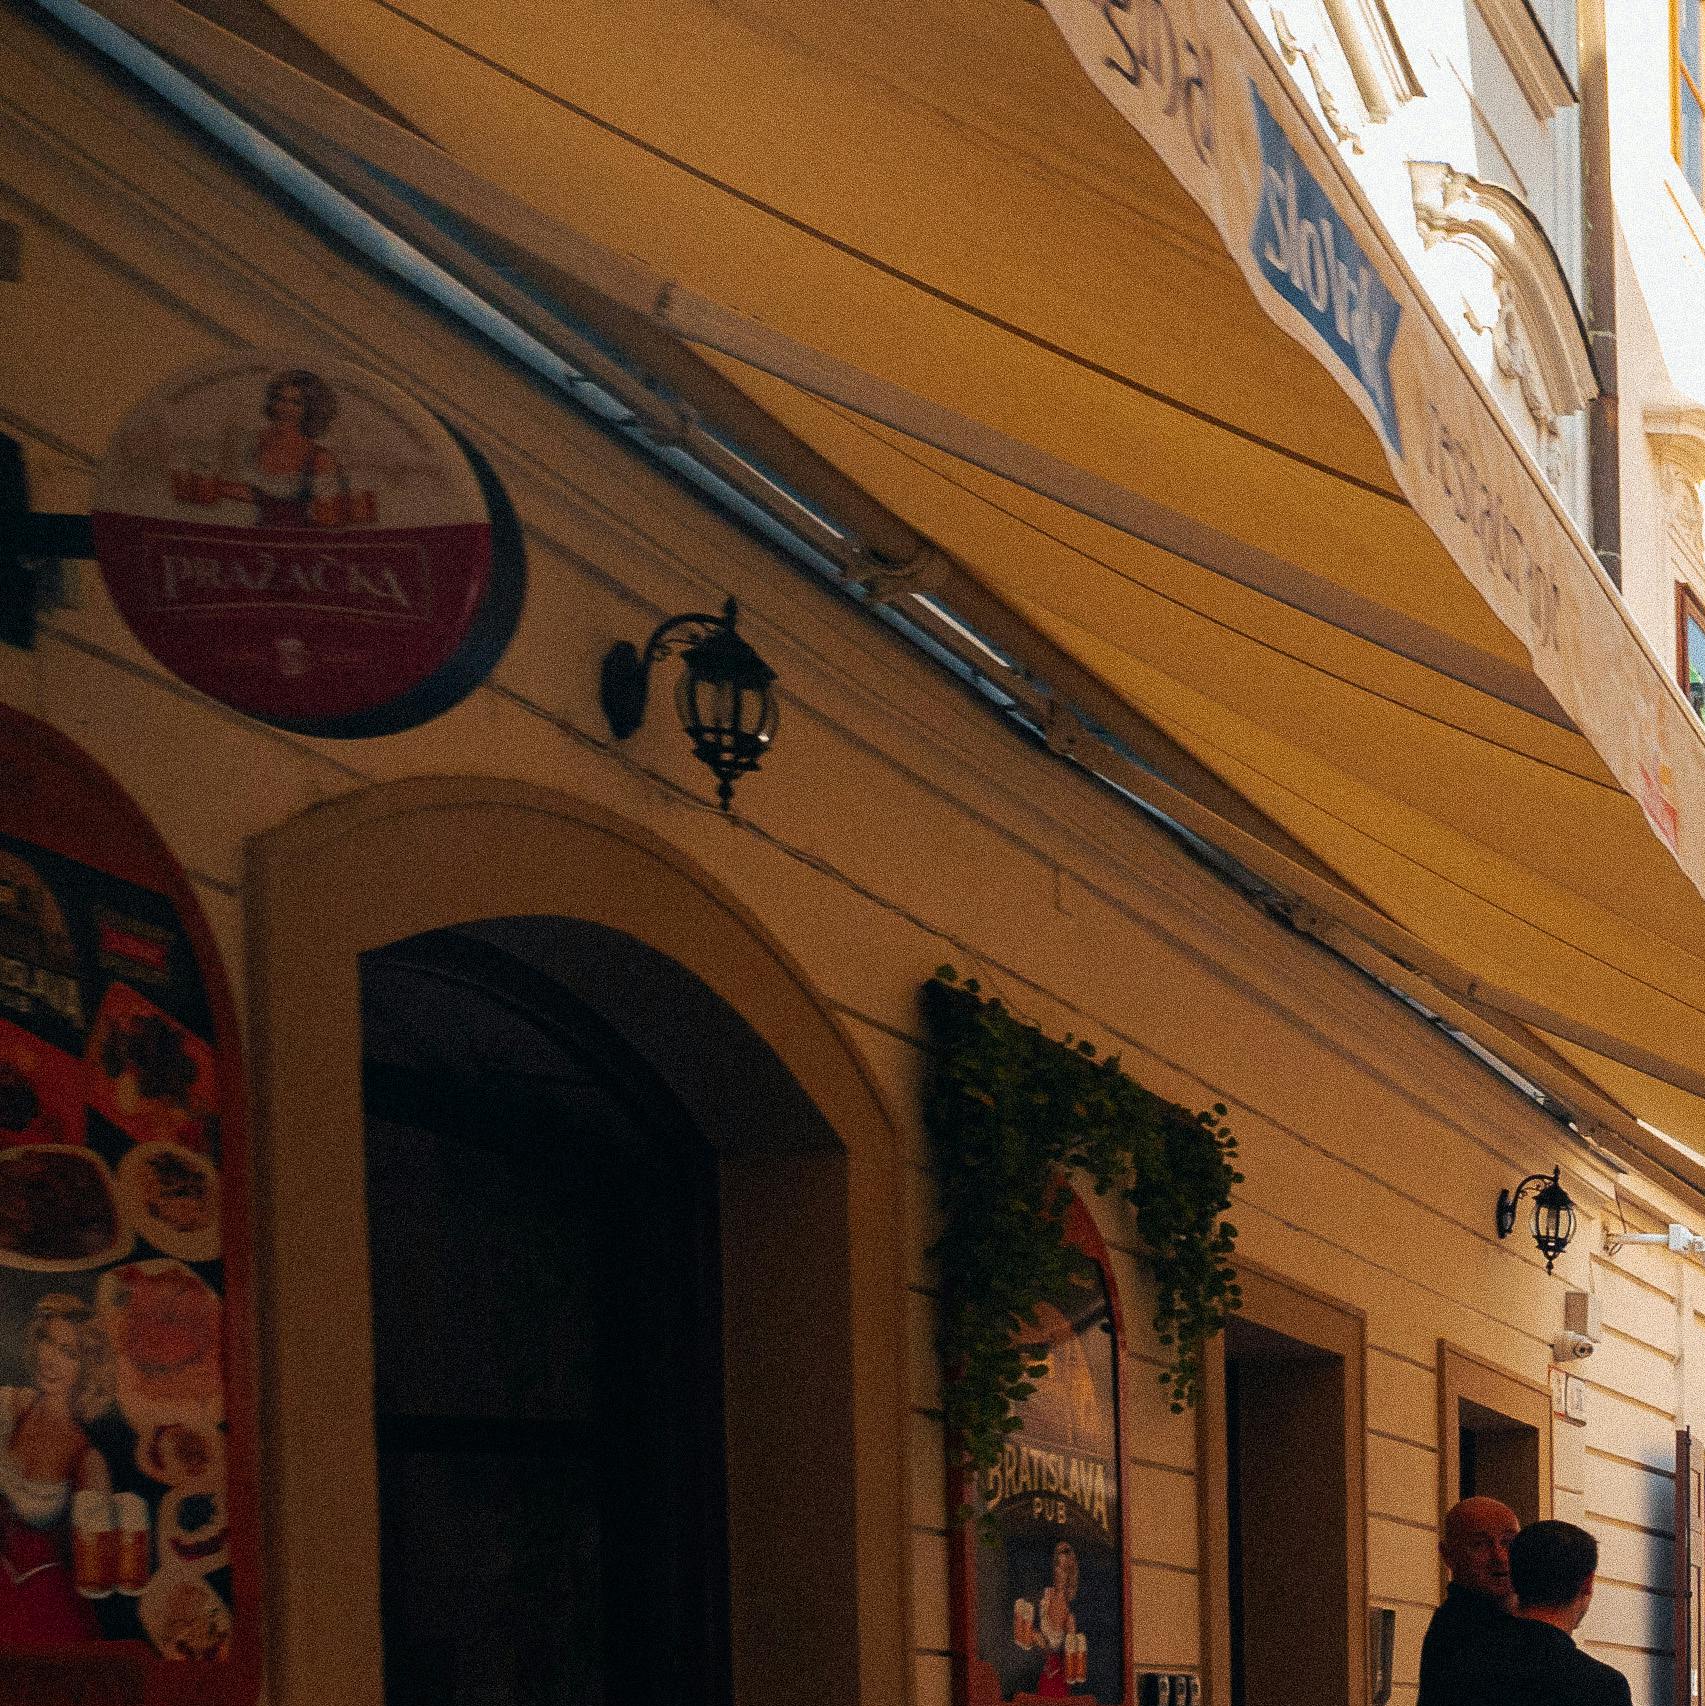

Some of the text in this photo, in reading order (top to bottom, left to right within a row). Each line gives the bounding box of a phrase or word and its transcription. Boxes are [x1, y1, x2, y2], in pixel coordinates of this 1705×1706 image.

[160, 550, 412, 608] PRAŽAČKA
[986, 1441, 1110, 1531] BRATISLAVA
[1032, 1495, 1068, 1526] PUB
